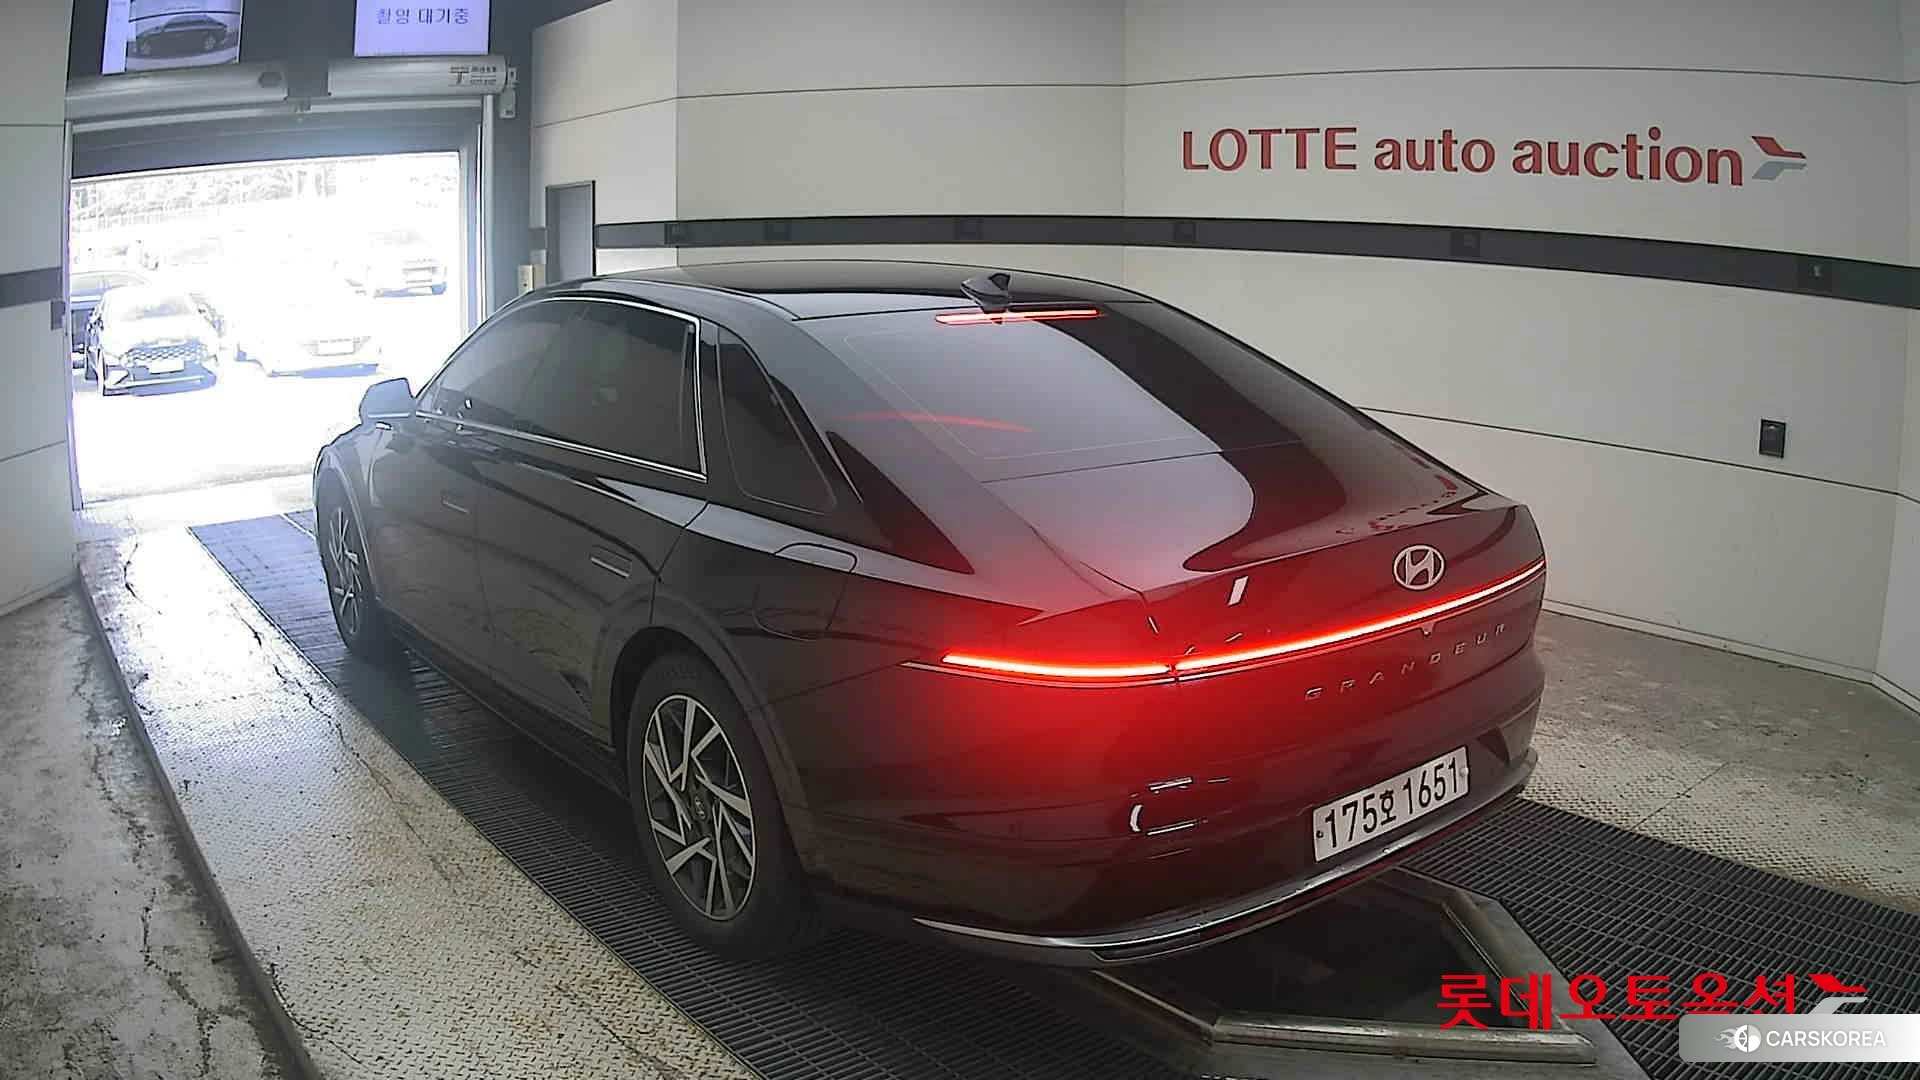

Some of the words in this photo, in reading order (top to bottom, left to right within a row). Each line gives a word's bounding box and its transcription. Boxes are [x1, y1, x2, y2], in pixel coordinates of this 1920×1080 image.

[418, 8, 470, 24] 대기중
[1182, 127, 1358, 171] LOTTE
[1373, 128, 1496, 173] auto
[1511, 126, 1744, 187] auction
[1304, 622, 1506, 701] GRANDEUR
[1324, 788, 1397, 848] 175호
[1402, 757, 1458, 815] 1651
